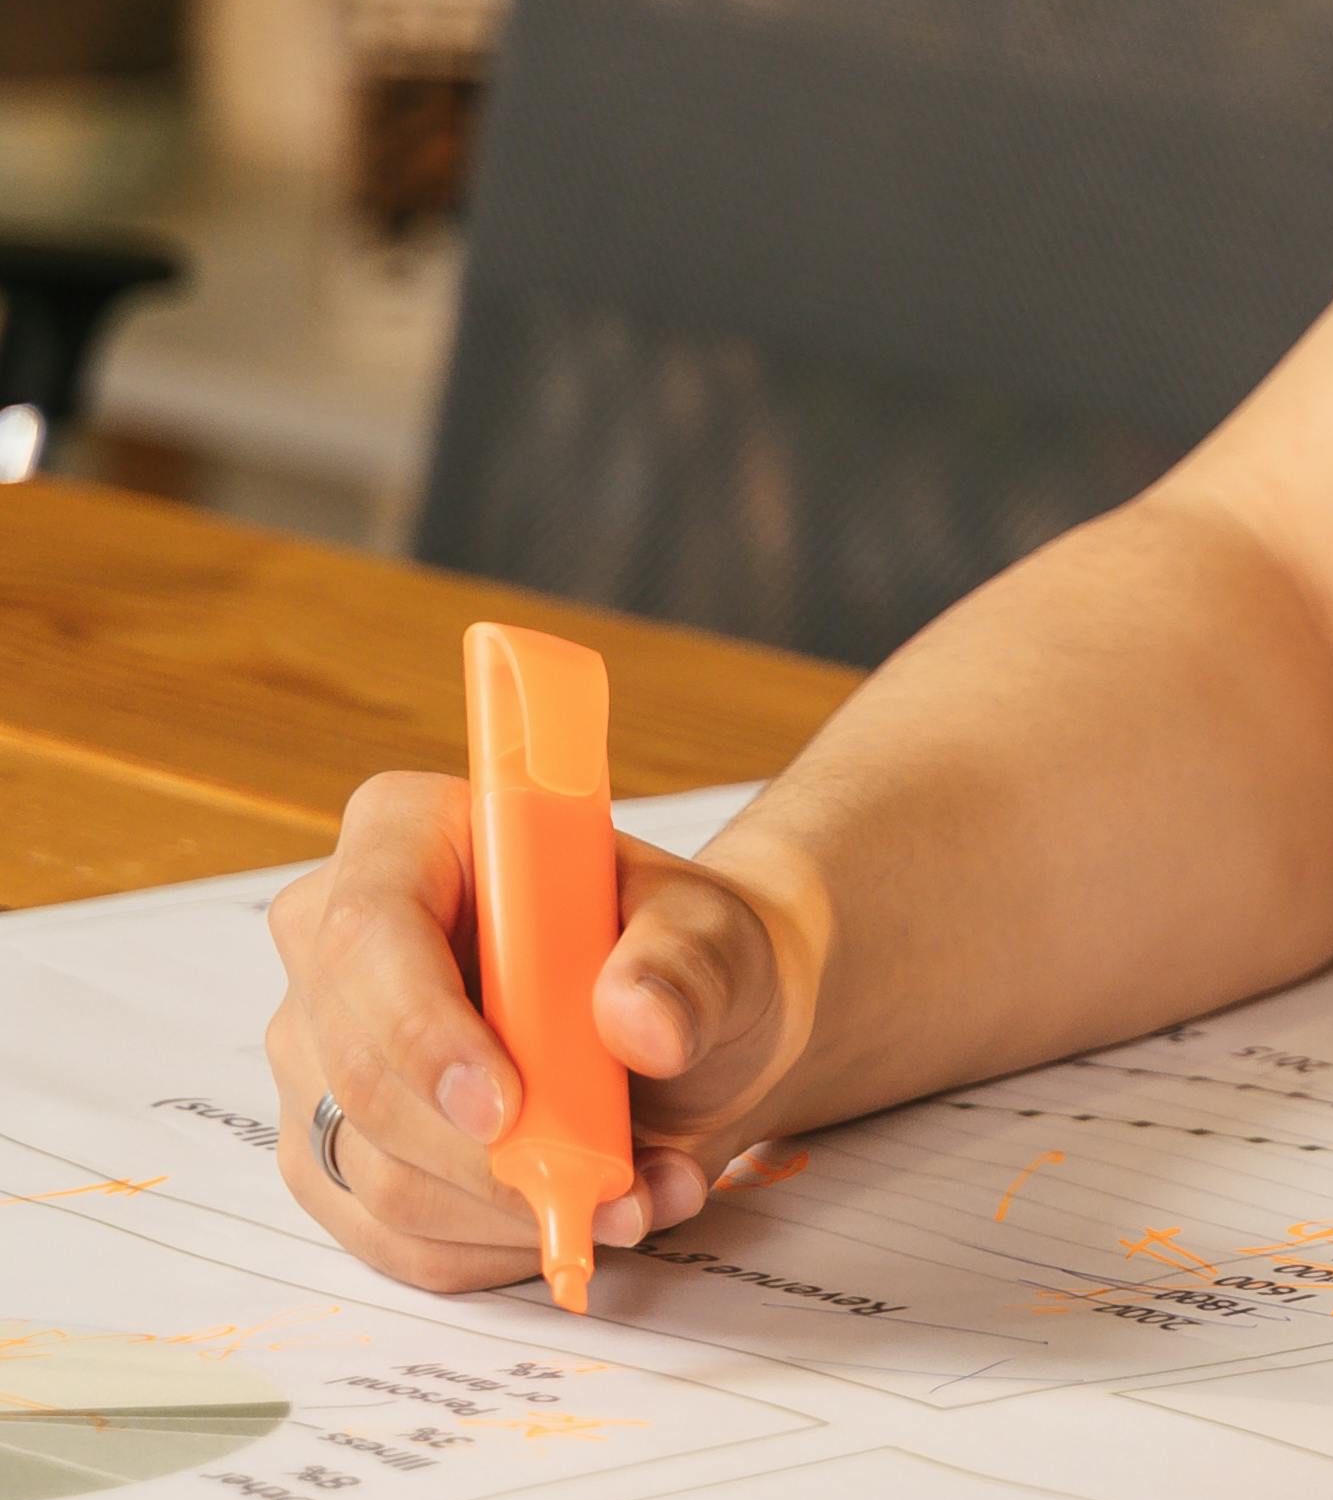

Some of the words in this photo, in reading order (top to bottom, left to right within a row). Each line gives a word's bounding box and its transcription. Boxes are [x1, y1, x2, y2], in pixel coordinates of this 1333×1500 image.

[148, 1096, 279, 1151] illions)
[629, 1239, 718, 1265] gro
[701, 1263, 909, 1316] Revenue
[1153, 1287, 1255, 1317] 1800
[1211, 1274, 1316, 1303] 1600
[1090, 1302, 1202, 1332] 2000
[389, 1361, 507, 1394] family
[493, 1360, 565, 1382] 4%
[323, 1372, 498, 1418] Personal
[502, 1386, 559, 1404] or
[315, 1429, 439, 1471] Illness
[395, 1423, 473, 1449] 3%
[283, 1462, 360, 1490] 8%
